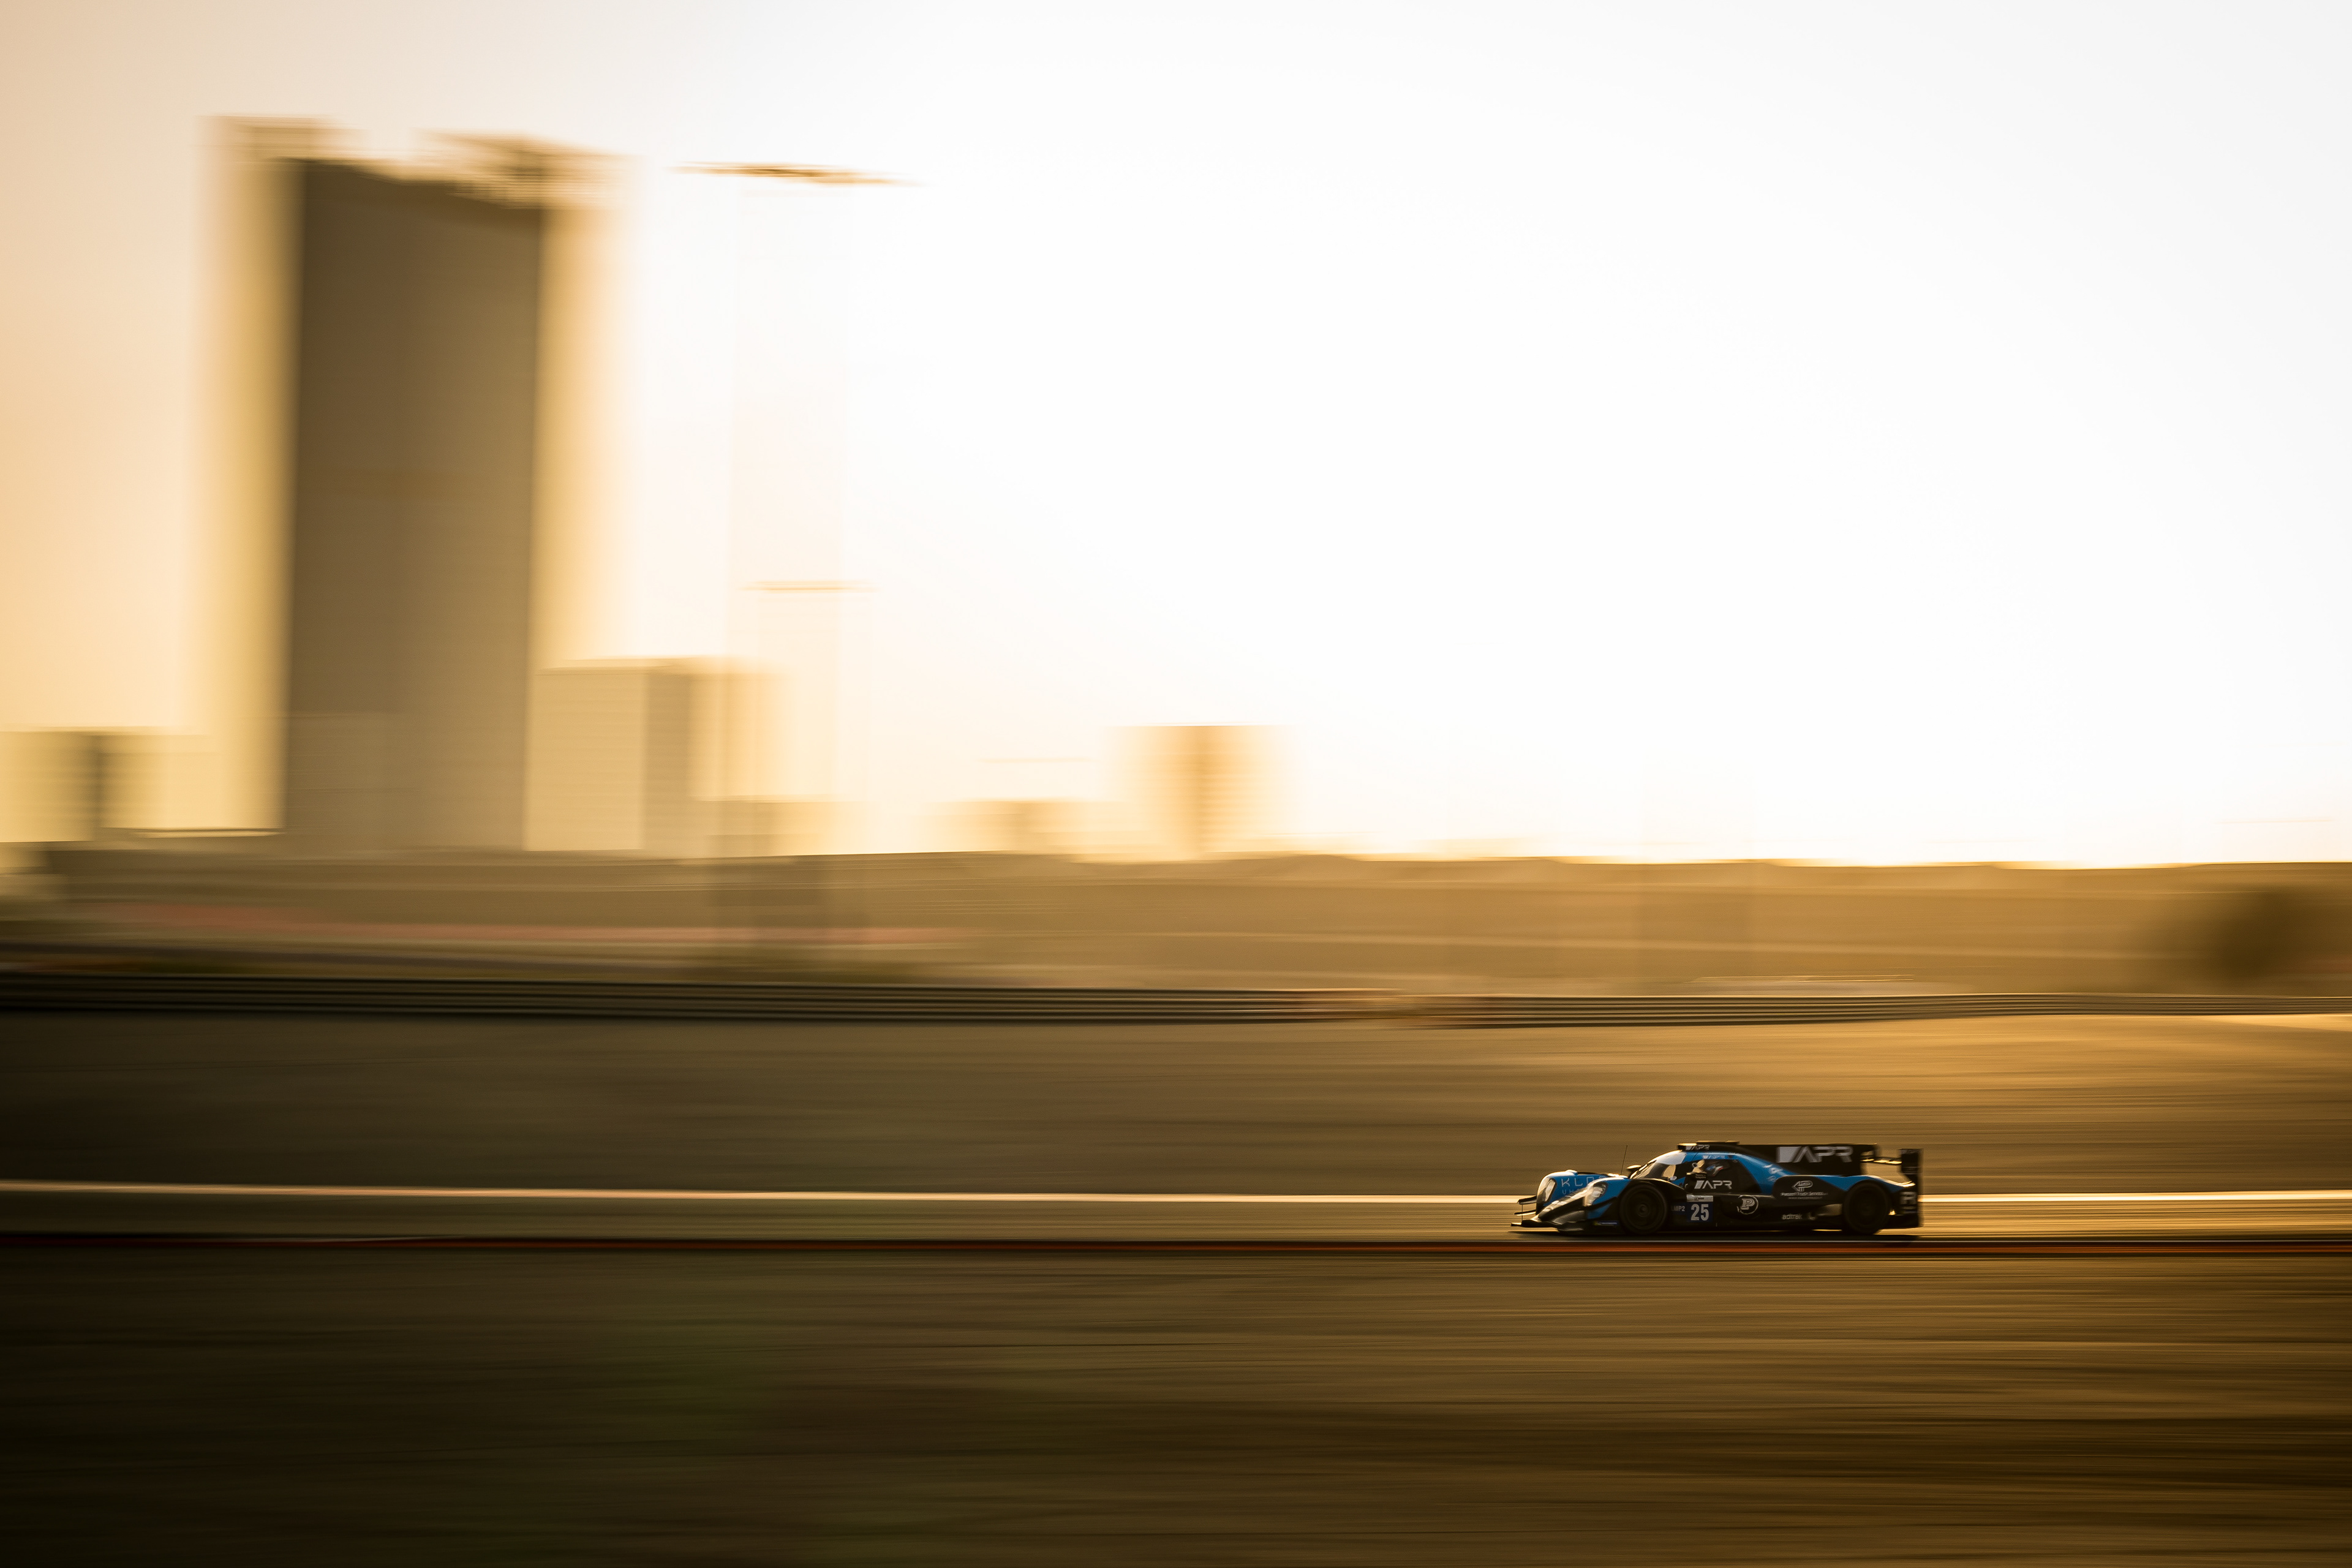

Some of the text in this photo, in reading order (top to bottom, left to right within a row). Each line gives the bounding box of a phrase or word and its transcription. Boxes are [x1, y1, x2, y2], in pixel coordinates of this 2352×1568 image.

[1792, 1146, 1853, 1163] APR
[1702, 1180, 1732, 1189] APR
[1691, 1204, 1709, 1221] 25
